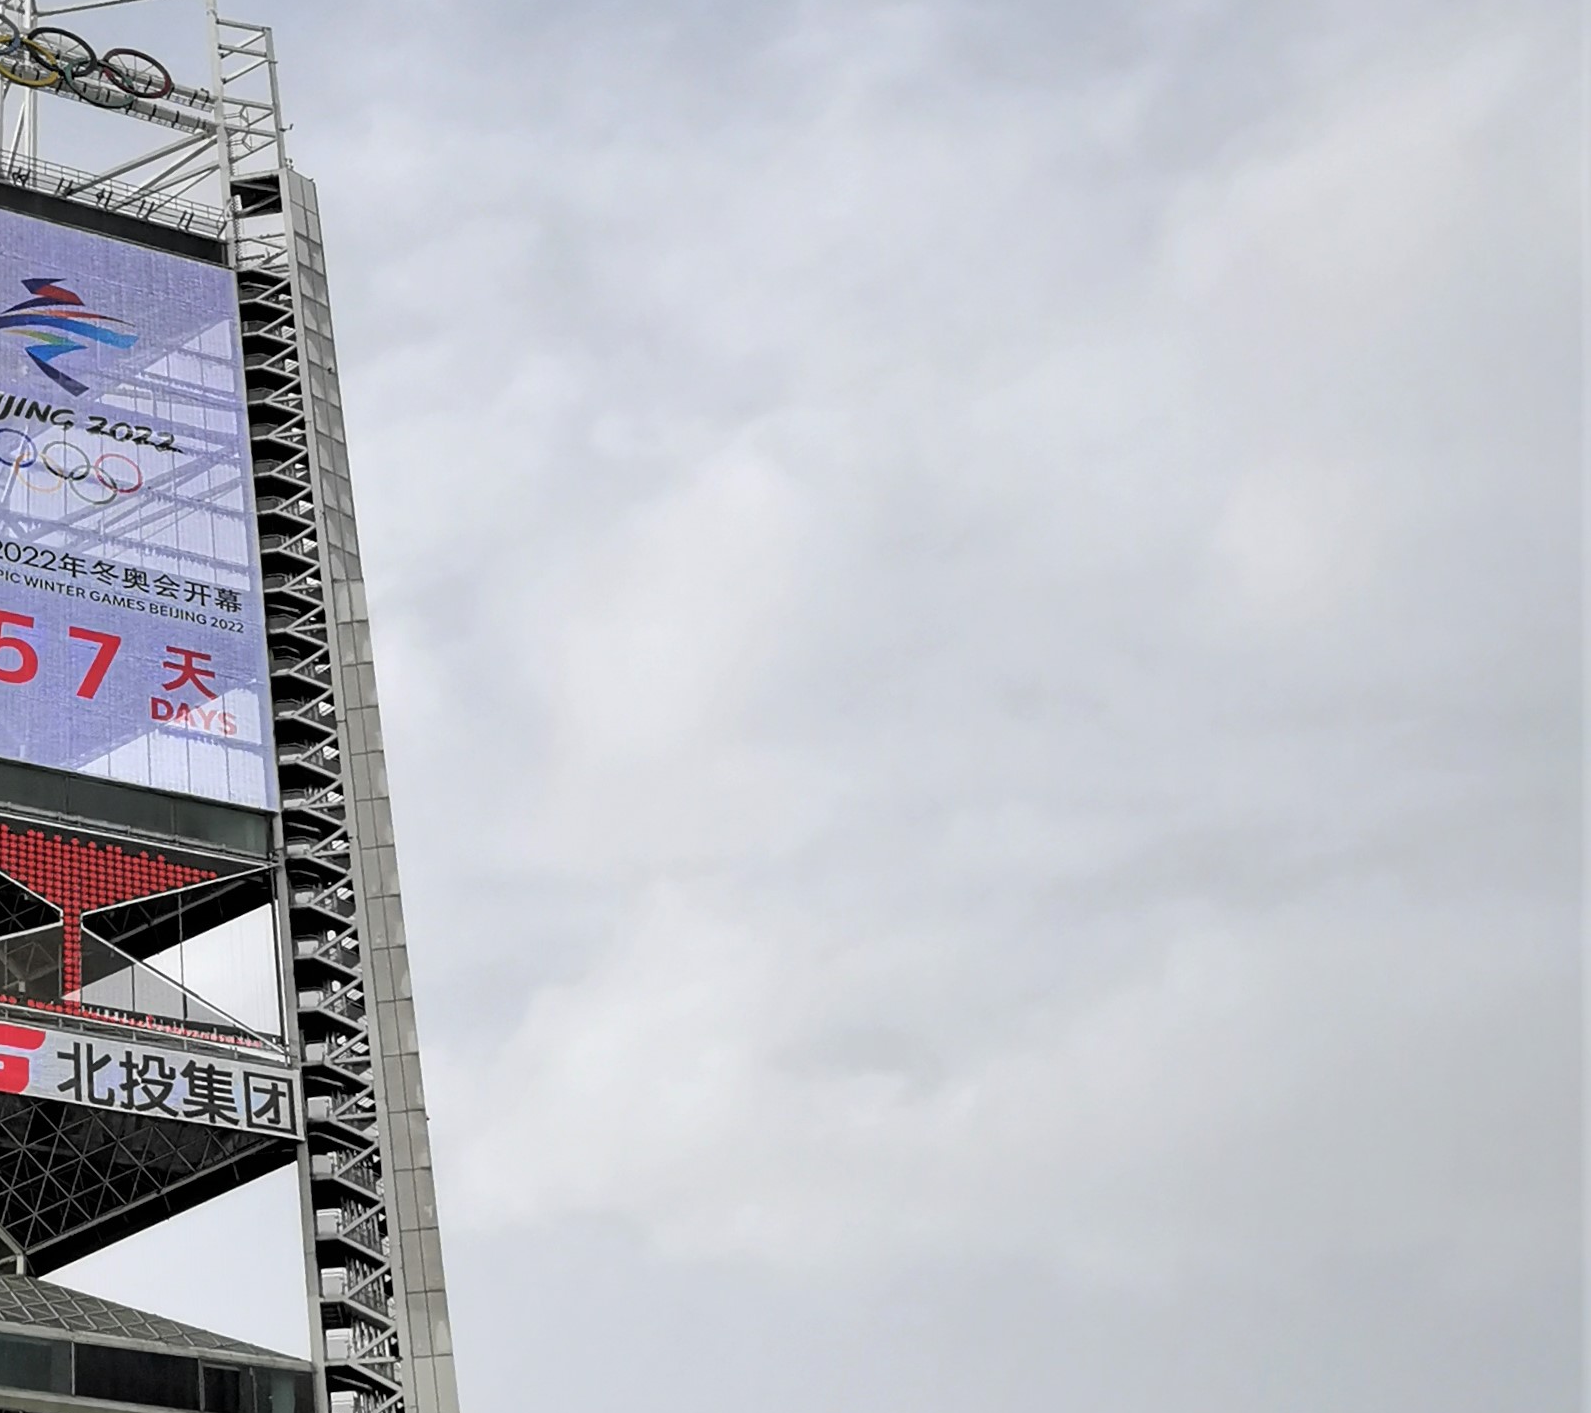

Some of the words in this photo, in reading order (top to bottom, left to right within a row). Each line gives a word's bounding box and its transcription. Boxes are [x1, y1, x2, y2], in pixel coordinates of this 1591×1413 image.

[86, 416, 188, 454] 2022
[24, 575, 85, 599] WINTER
[90, 590, 145, 612] GAMES
[149, 603, 207, 625] BEIJING
[210, 617, 244, 634] 2022
[162, 645, 218, 700] 天
[150, 697, 238, 736] DAYS
[57, 1041, 298, 1134] 北投集团
